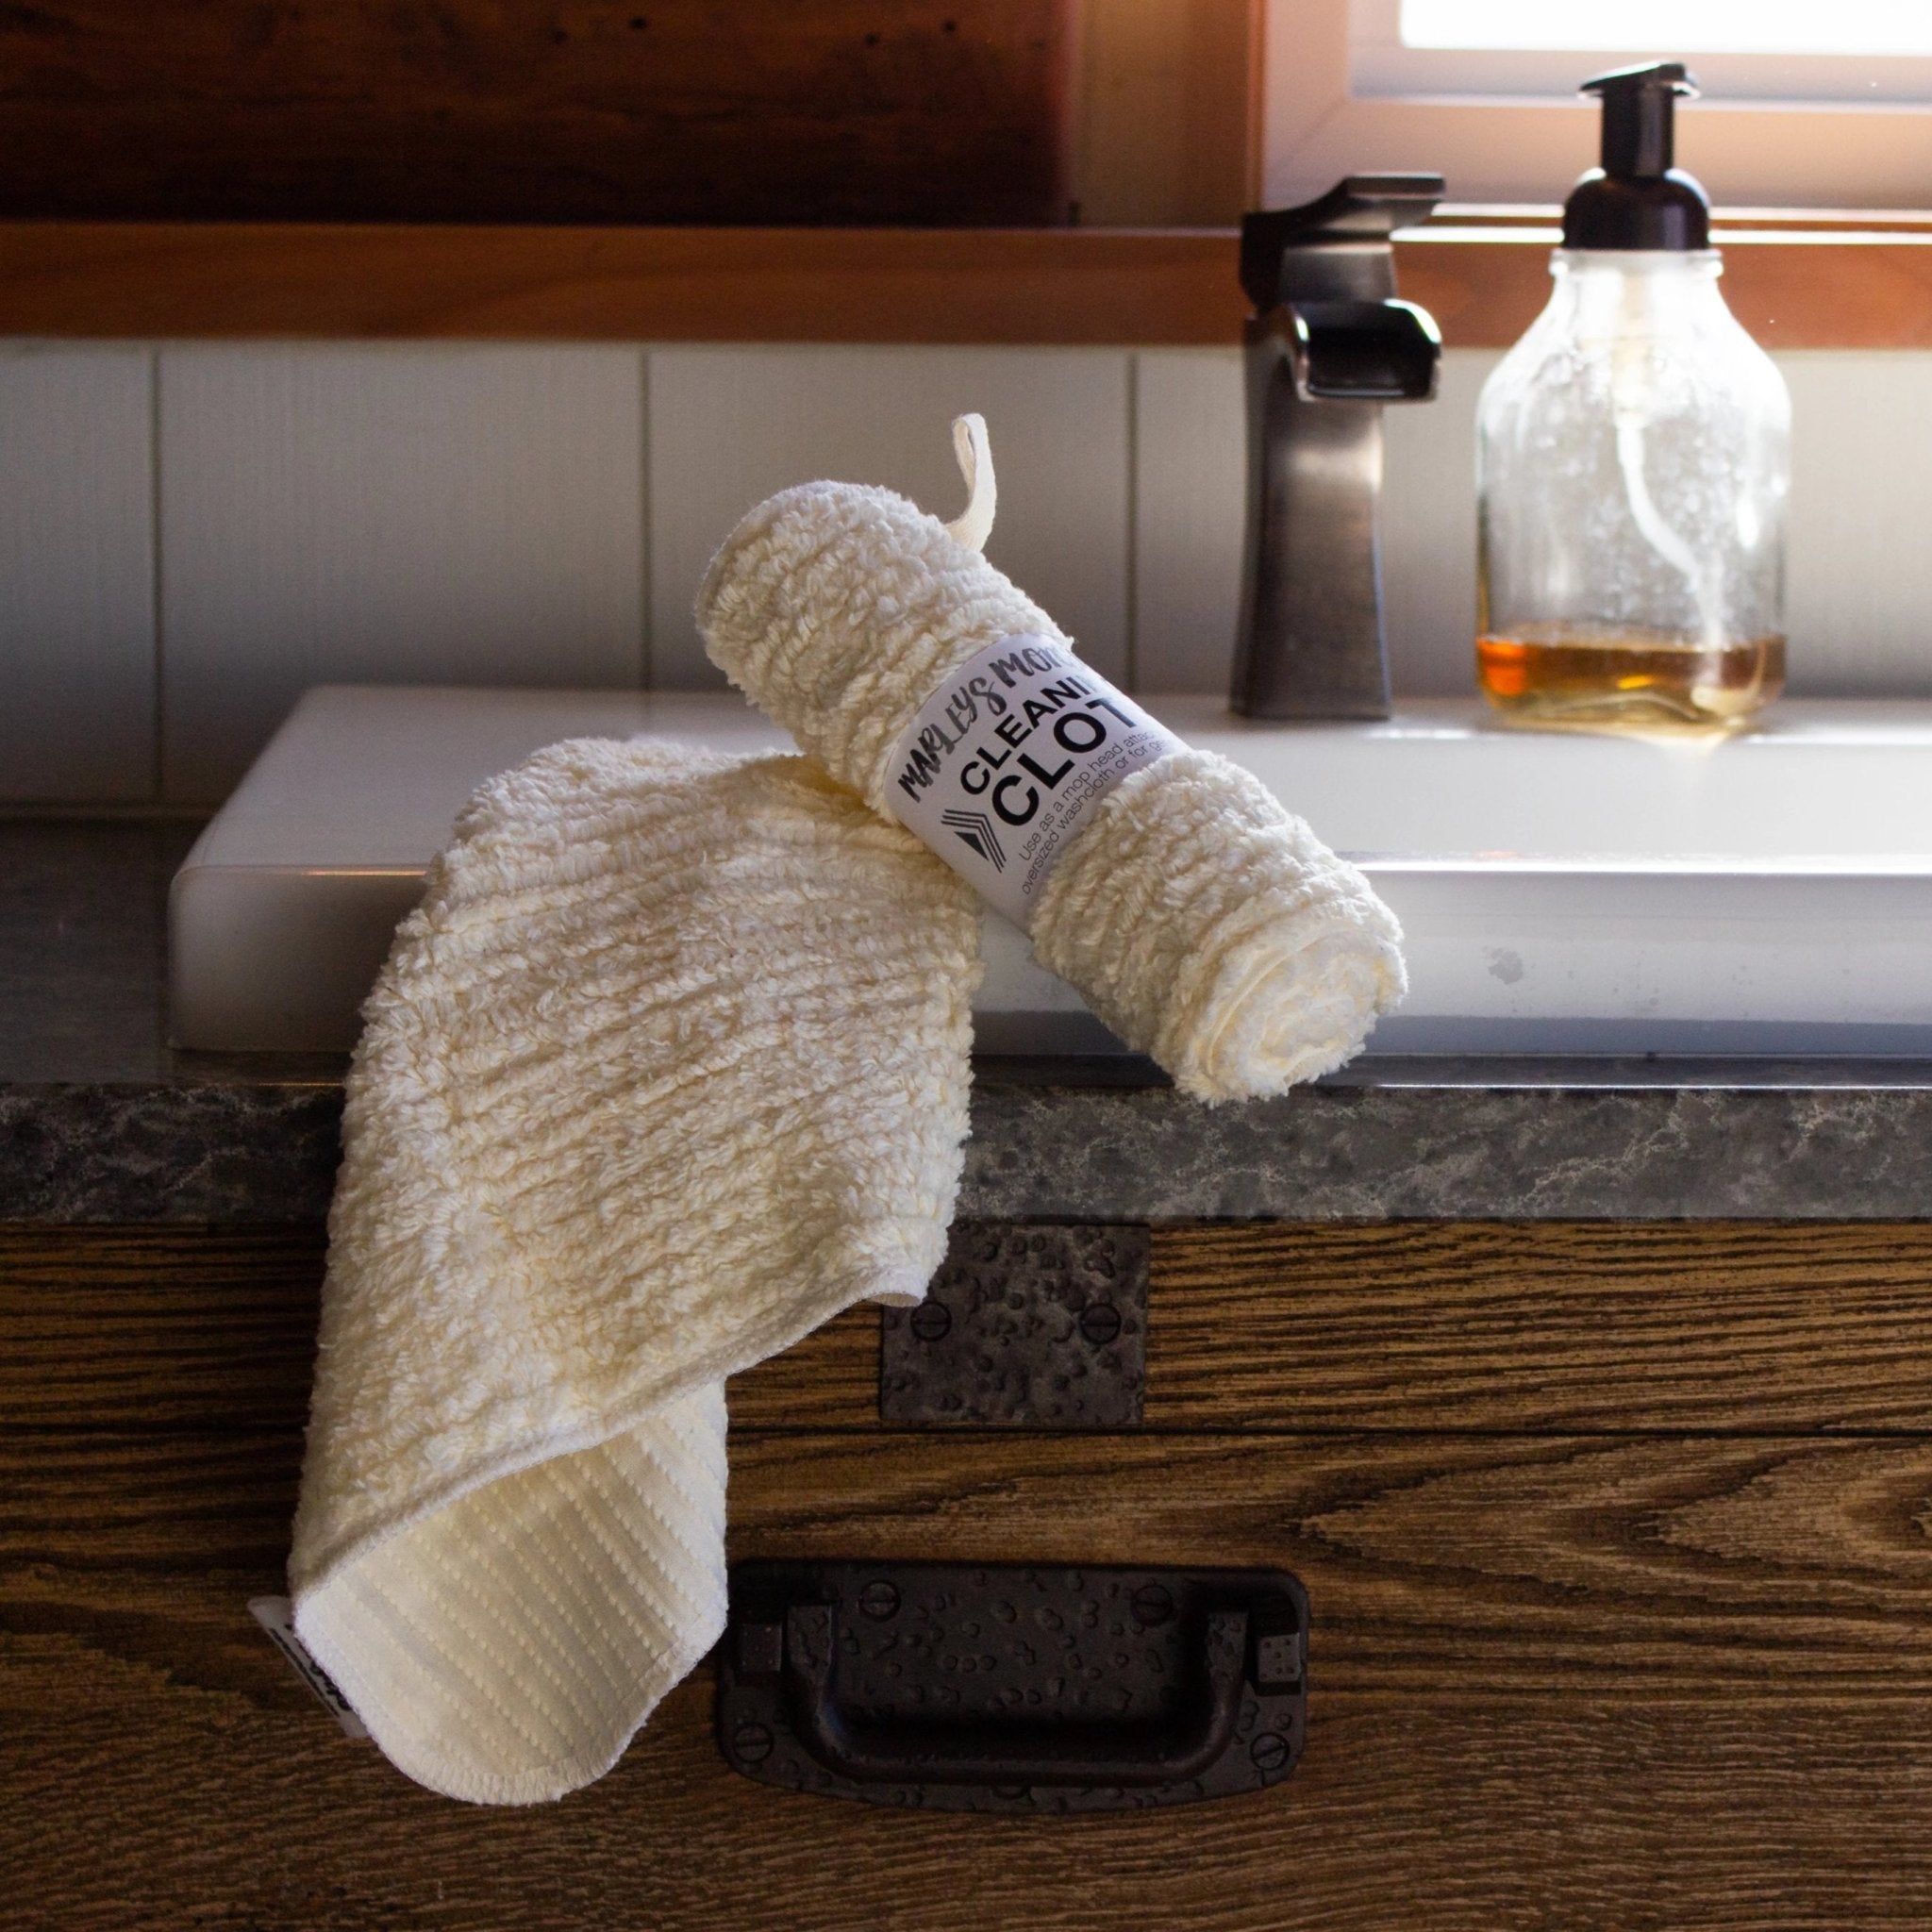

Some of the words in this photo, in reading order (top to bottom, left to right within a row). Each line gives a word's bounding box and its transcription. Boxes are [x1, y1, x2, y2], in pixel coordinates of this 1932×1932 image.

[898, 677, 1007, 803] MARLEYS
[960, 676, 1097, 794] CLEANI
[992, 696, 1137, 826] CLOT
[1019, 832, 1041, 861] Use
[1039, 812, 1056, 831] as
[1053, 801, 1064, 812] a
[1061, 771, 1091, 801] mop
[1087, 742, 1124, 772] head
[1022, 829, 1060, 895] oversized
[1057, 768, 1115, 830] washcloth
[1115, 756, 1130, 769] or
[1127, 745, 1148, 758] for
